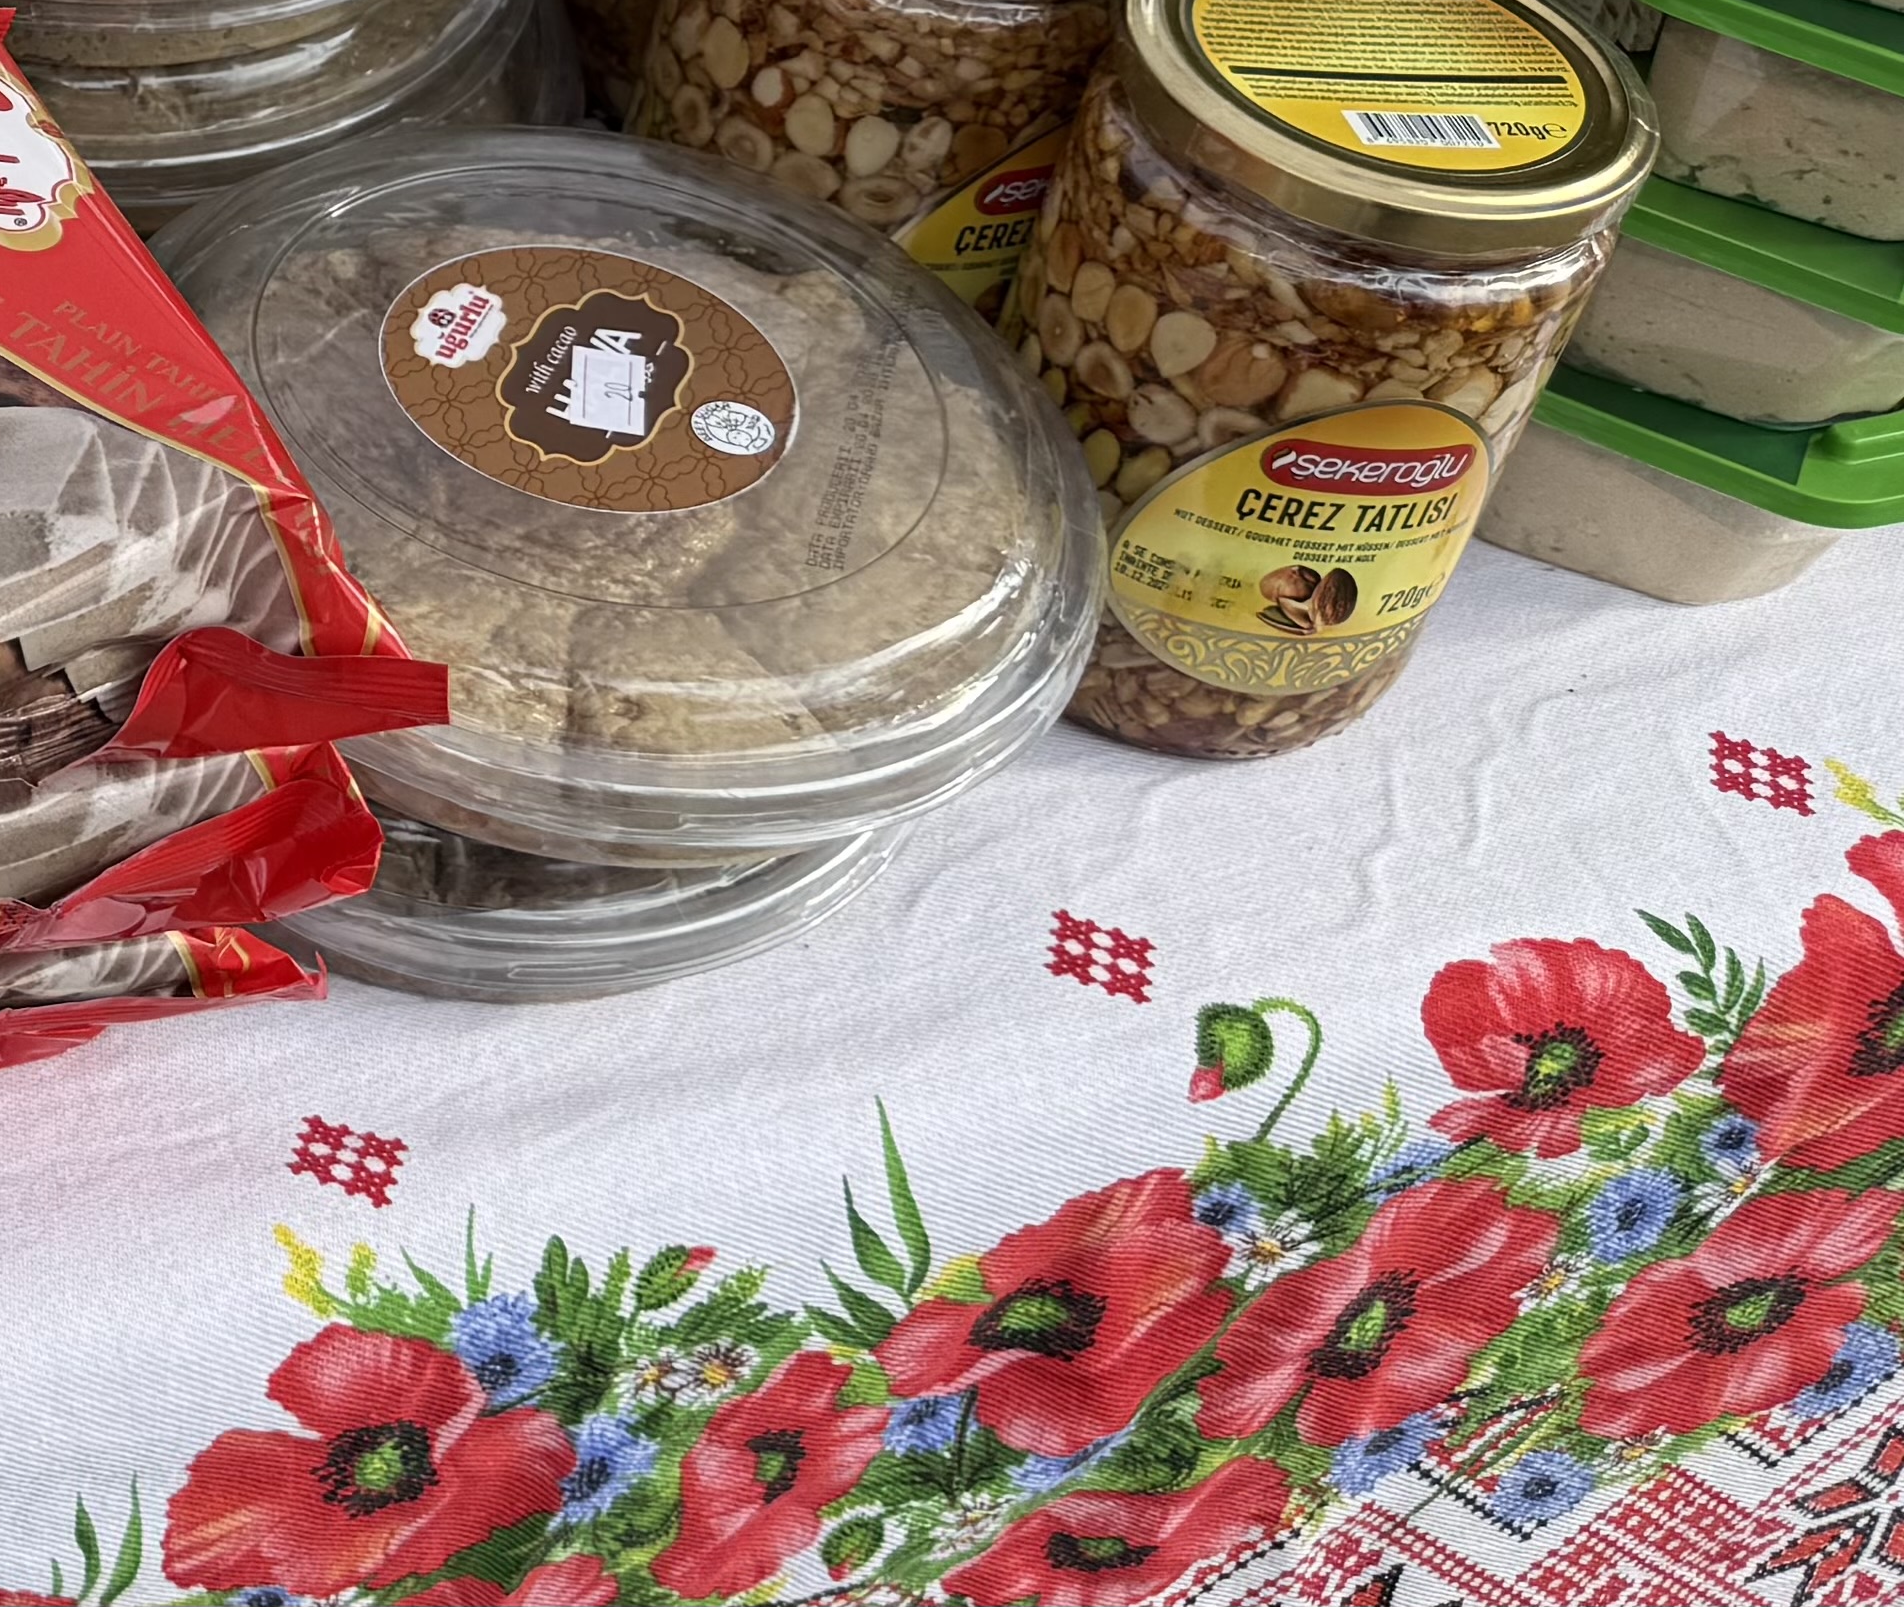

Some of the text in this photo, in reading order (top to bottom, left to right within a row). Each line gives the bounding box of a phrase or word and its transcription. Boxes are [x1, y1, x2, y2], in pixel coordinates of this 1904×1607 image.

[1486, 119, 1545, 142] 720g
[955, 218, 1036, 257] ÇEREZ
[525, 325, 579, 395] with cacao
[1235, 488, 1459, 533] ÇEREZ TATLISI
[1376, 584, 1424, 618] 720g
